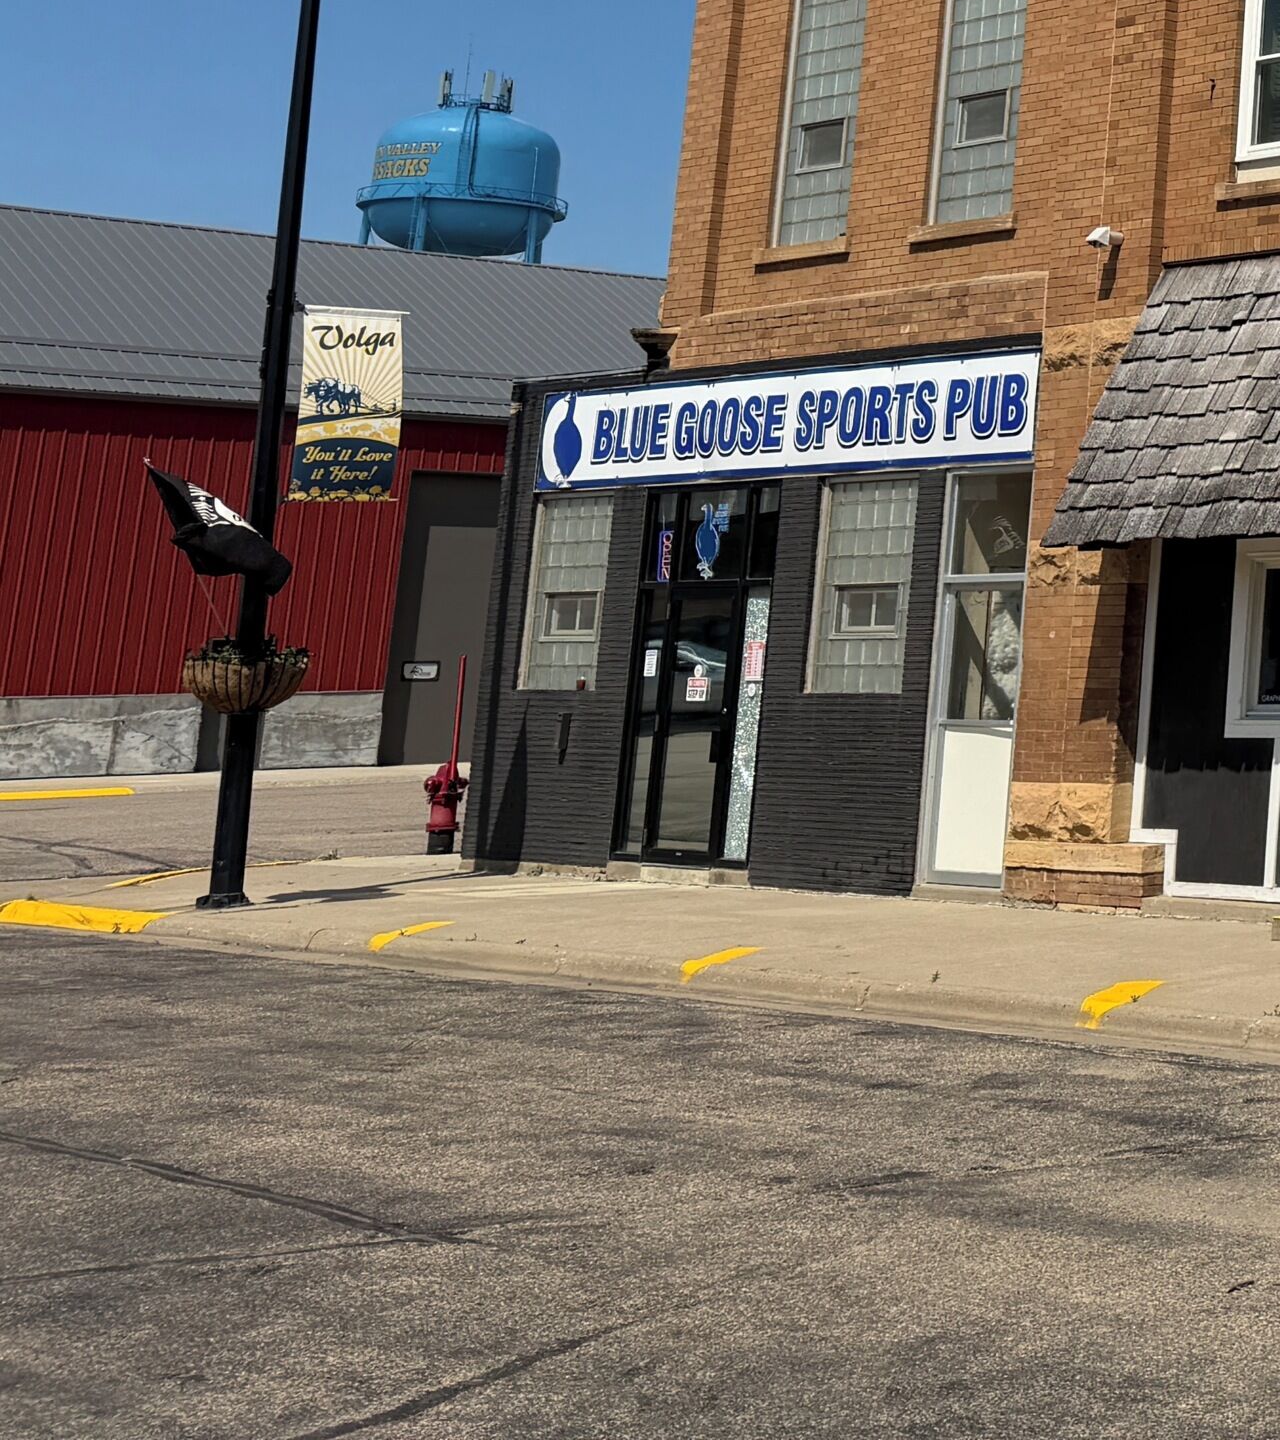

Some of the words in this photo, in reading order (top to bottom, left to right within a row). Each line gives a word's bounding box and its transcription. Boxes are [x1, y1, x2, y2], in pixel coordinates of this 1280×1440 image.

[386, 141, 442, 156] VALLEY
[311, 325, 396, 356] Volga
[590, 402, 672, 465] BLUE
[673, 391, 788, 460] GOOSE
[794, 377, 938, 453] SPORTS
[943, 371, 1029, 441] PUB
[302, 446, 352, 464] You'll
[353, 446, 393, 462] Love
[310, 468, 325, 480] it
[329, 465, 378, 483] Here!
[662, 532, 674, 580] OPEN
